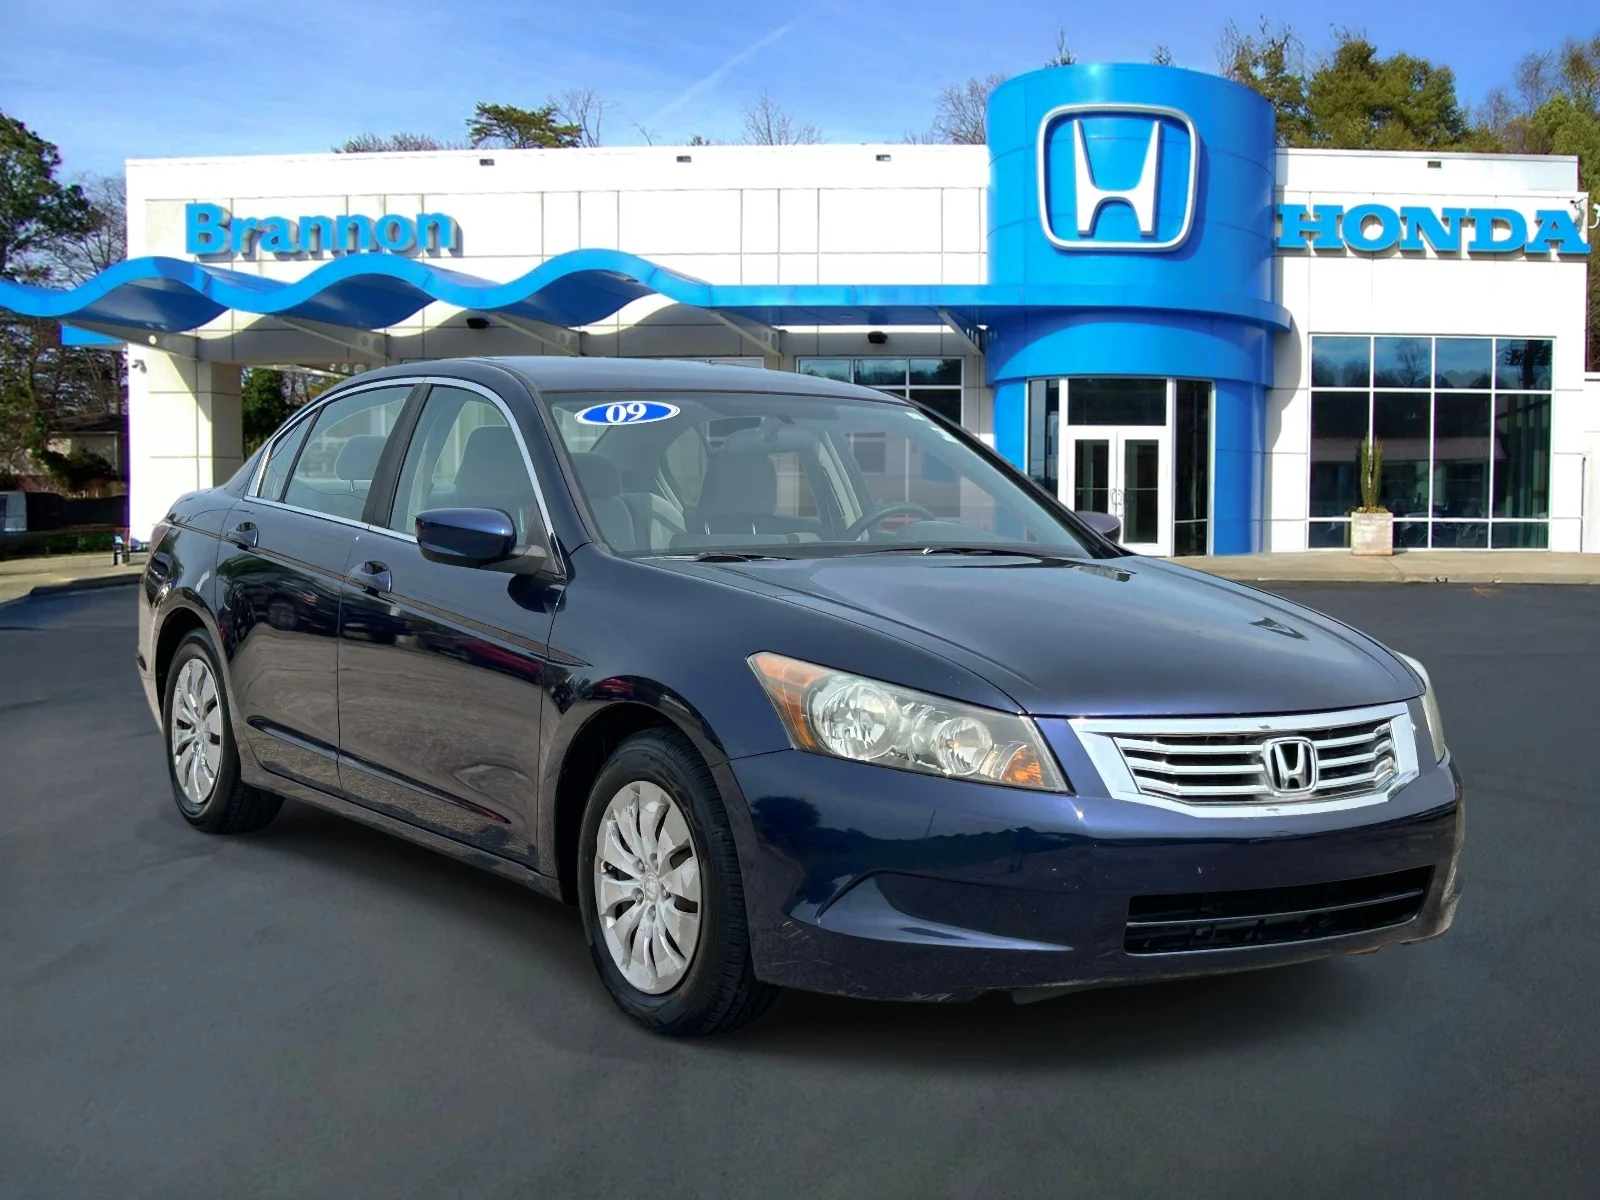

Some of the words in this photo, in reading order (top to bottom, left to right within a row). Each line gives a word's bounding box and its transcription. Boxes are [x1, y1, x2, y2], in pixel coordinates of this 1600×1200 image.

[185, 203, 456, 255] Brannon
[1277, 203, 1591, 254] HONDA
[605, 403, 647, 423] 09
